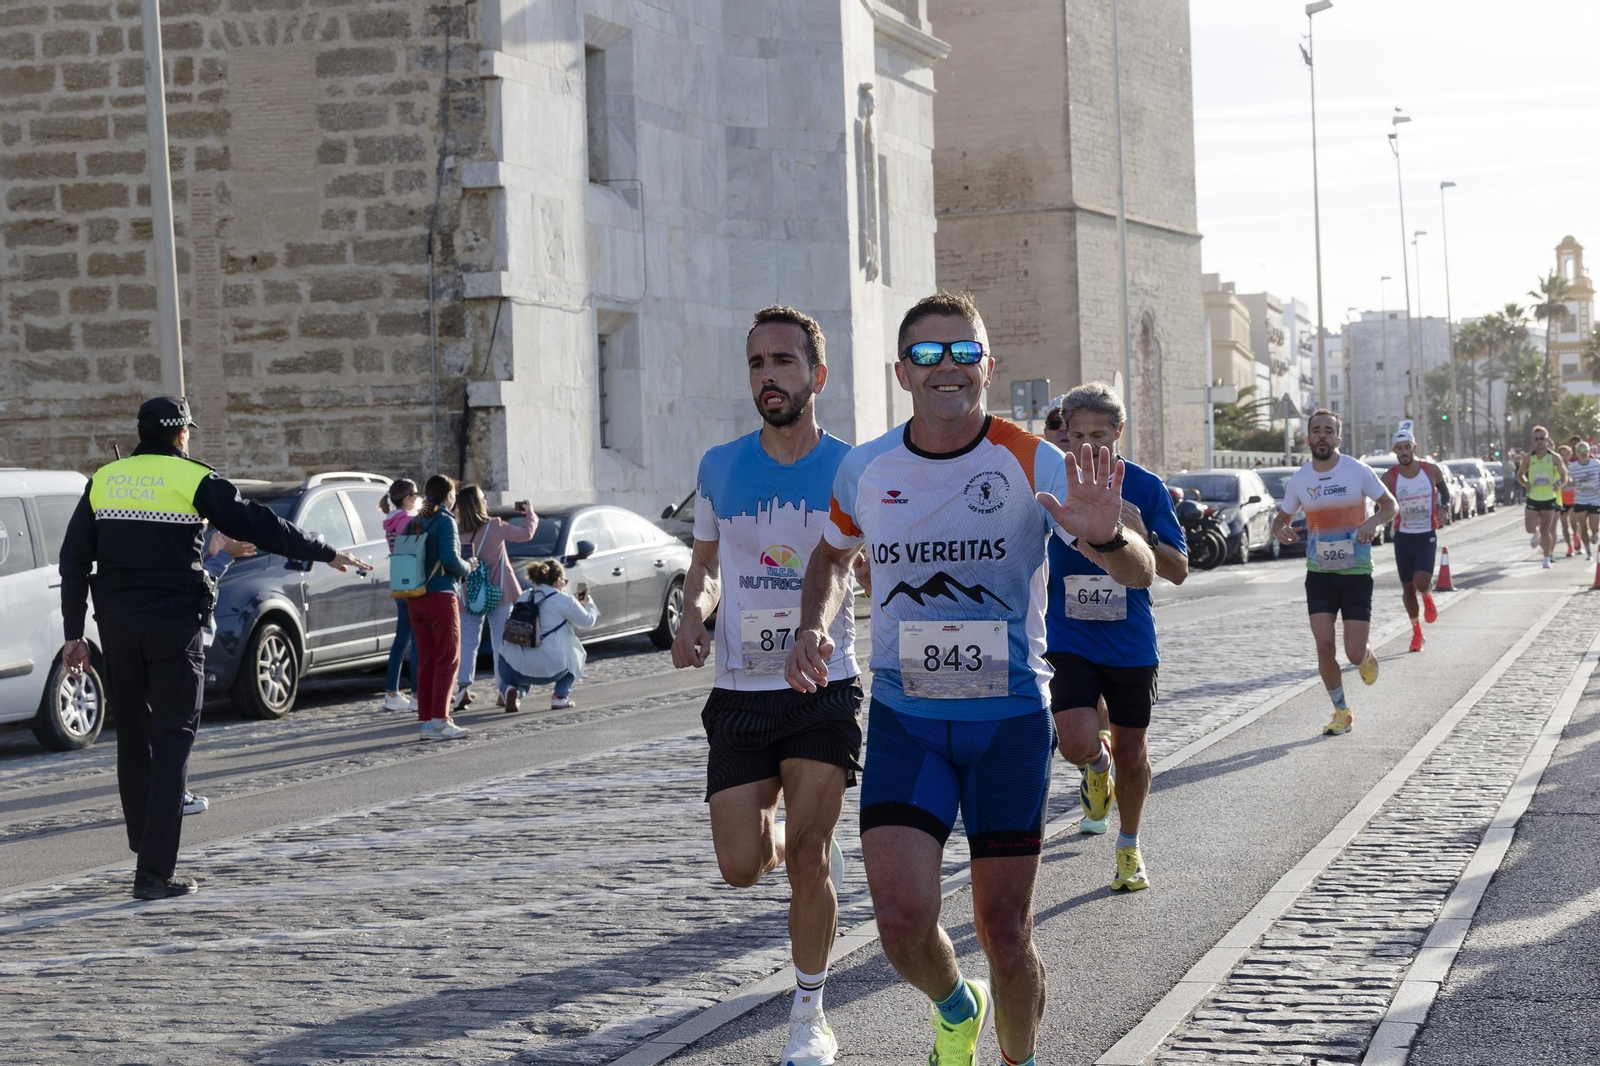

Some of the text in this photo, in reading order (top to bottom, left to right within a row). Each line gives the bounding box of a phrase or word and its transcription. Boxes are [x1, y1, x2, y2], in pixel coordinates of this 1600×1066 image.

[106, 474, 165, 487] POLICIA
[108, 487, 157, 500] LOCAL
[1323, 486, 1347, 496] CORRE
[872, 538, 1006, 564] LOS VEREITAS
[1323, 550, 1345, 561] 526
[1077, 588, 1113, 605] 647
[923, 644, 983, 672] 843
